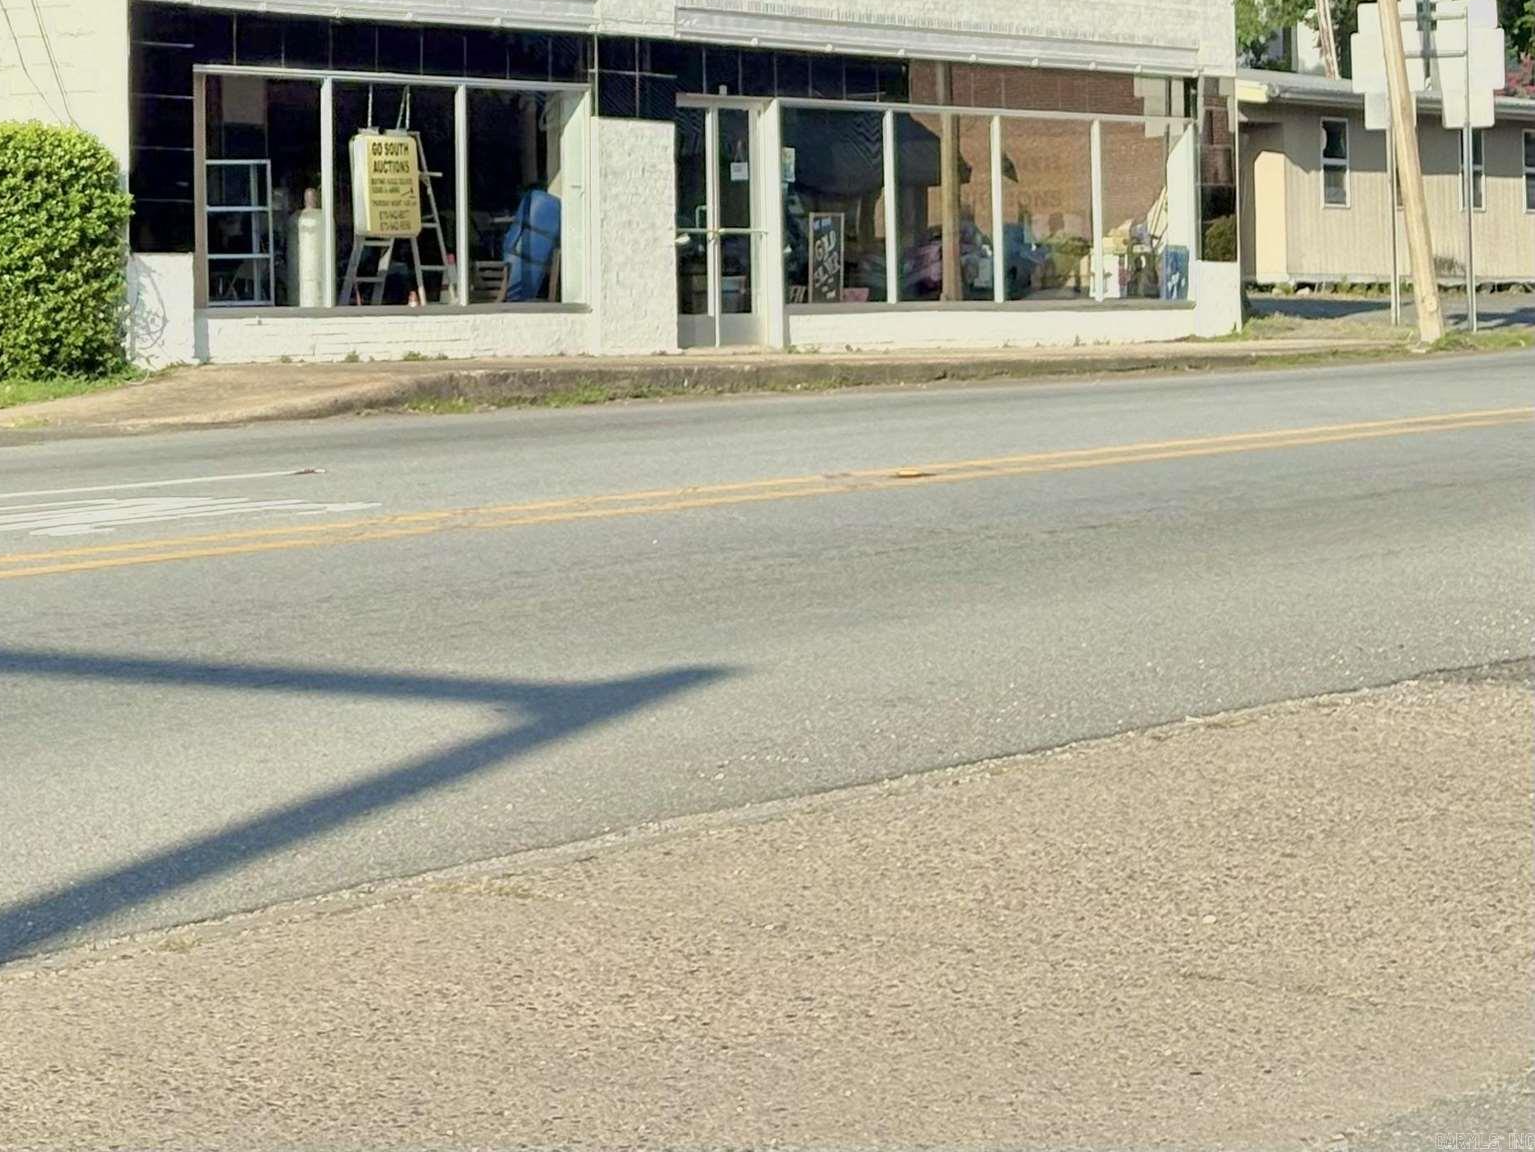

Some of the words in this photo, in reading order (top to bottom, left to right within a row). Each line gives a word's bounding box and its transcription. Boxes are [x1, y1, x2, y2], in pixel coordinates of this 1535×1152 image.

[371, 142, 383, 155] GO
[385, 142, 409, 155] SOUTH
[373, 160, 410, 174] AUCTIONS
